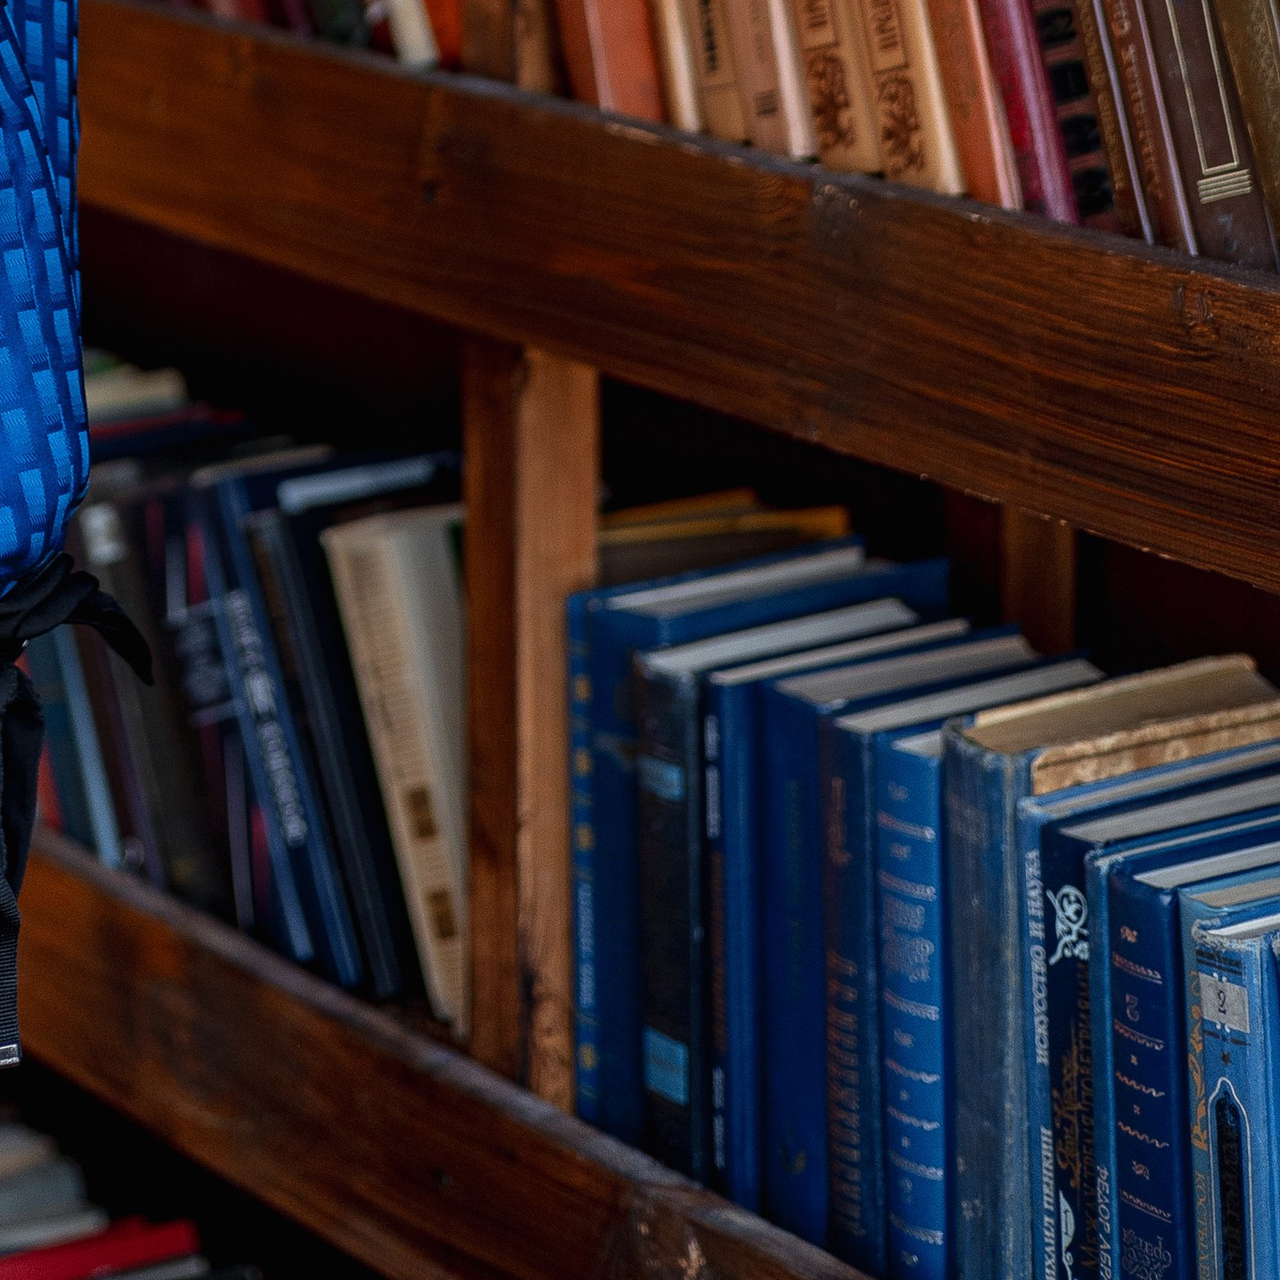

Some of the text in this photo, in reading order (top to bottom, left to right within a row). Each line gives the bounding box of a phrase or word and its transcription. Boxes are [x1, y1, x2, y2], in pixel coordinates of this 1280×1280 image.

[1025, 848, 1049, 1064] ИСКУССТВО И НАУКА
[1039, 1127, 1057, 1280] ИХАИЛ ПЕНКИН
[1096, 1166, 1111, 1233] ФЕДОР
